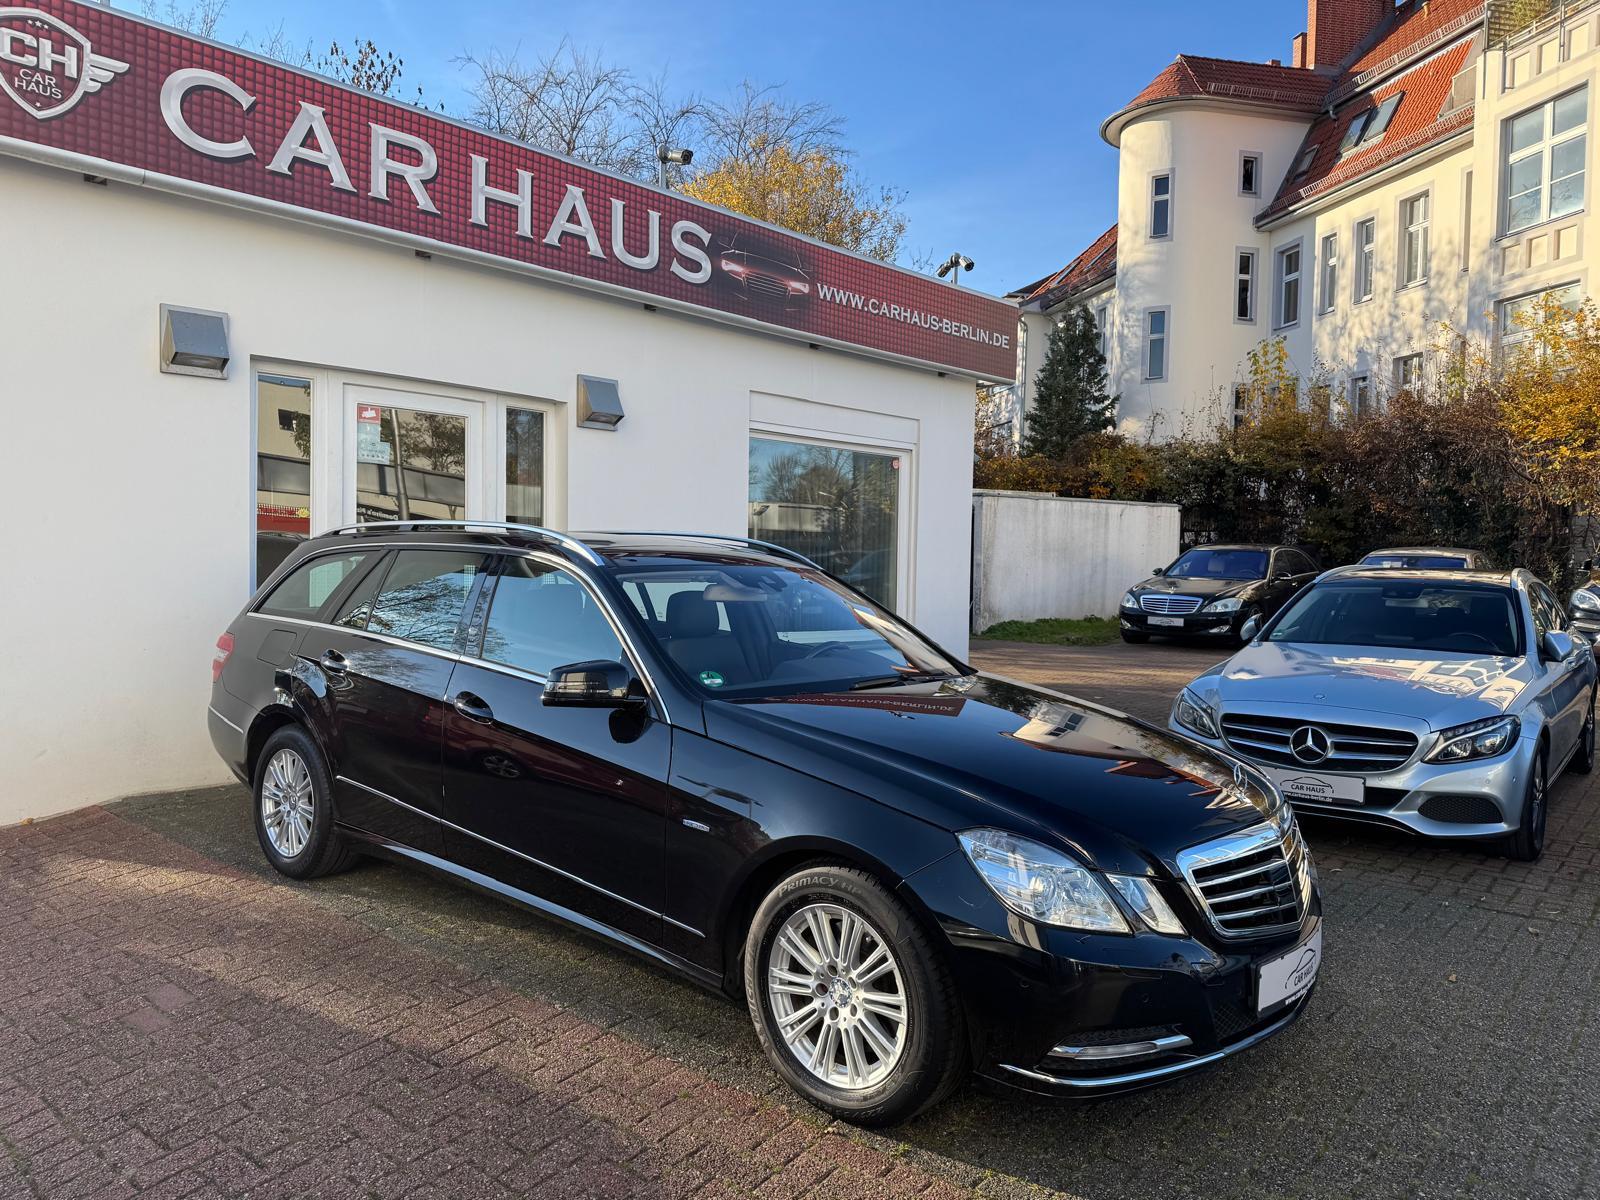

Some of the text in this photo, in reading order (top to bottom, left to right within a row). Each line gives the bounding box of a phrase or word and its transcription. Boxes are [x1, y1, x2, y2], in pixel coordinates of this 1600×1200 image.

[0, 27, 78, 79] CH
[14, 77, 62, 99] HAUS
[20, 68, 56, 88] CAR
[160, 68, 712, 284] CAR HAUS
[817, 283, 1009, 349] WWW.CARHAUS-BERLIN.DE
[1290, 784, 1325, 794] CAR HAUS
[1294, 972, 1304, 986] CAR
